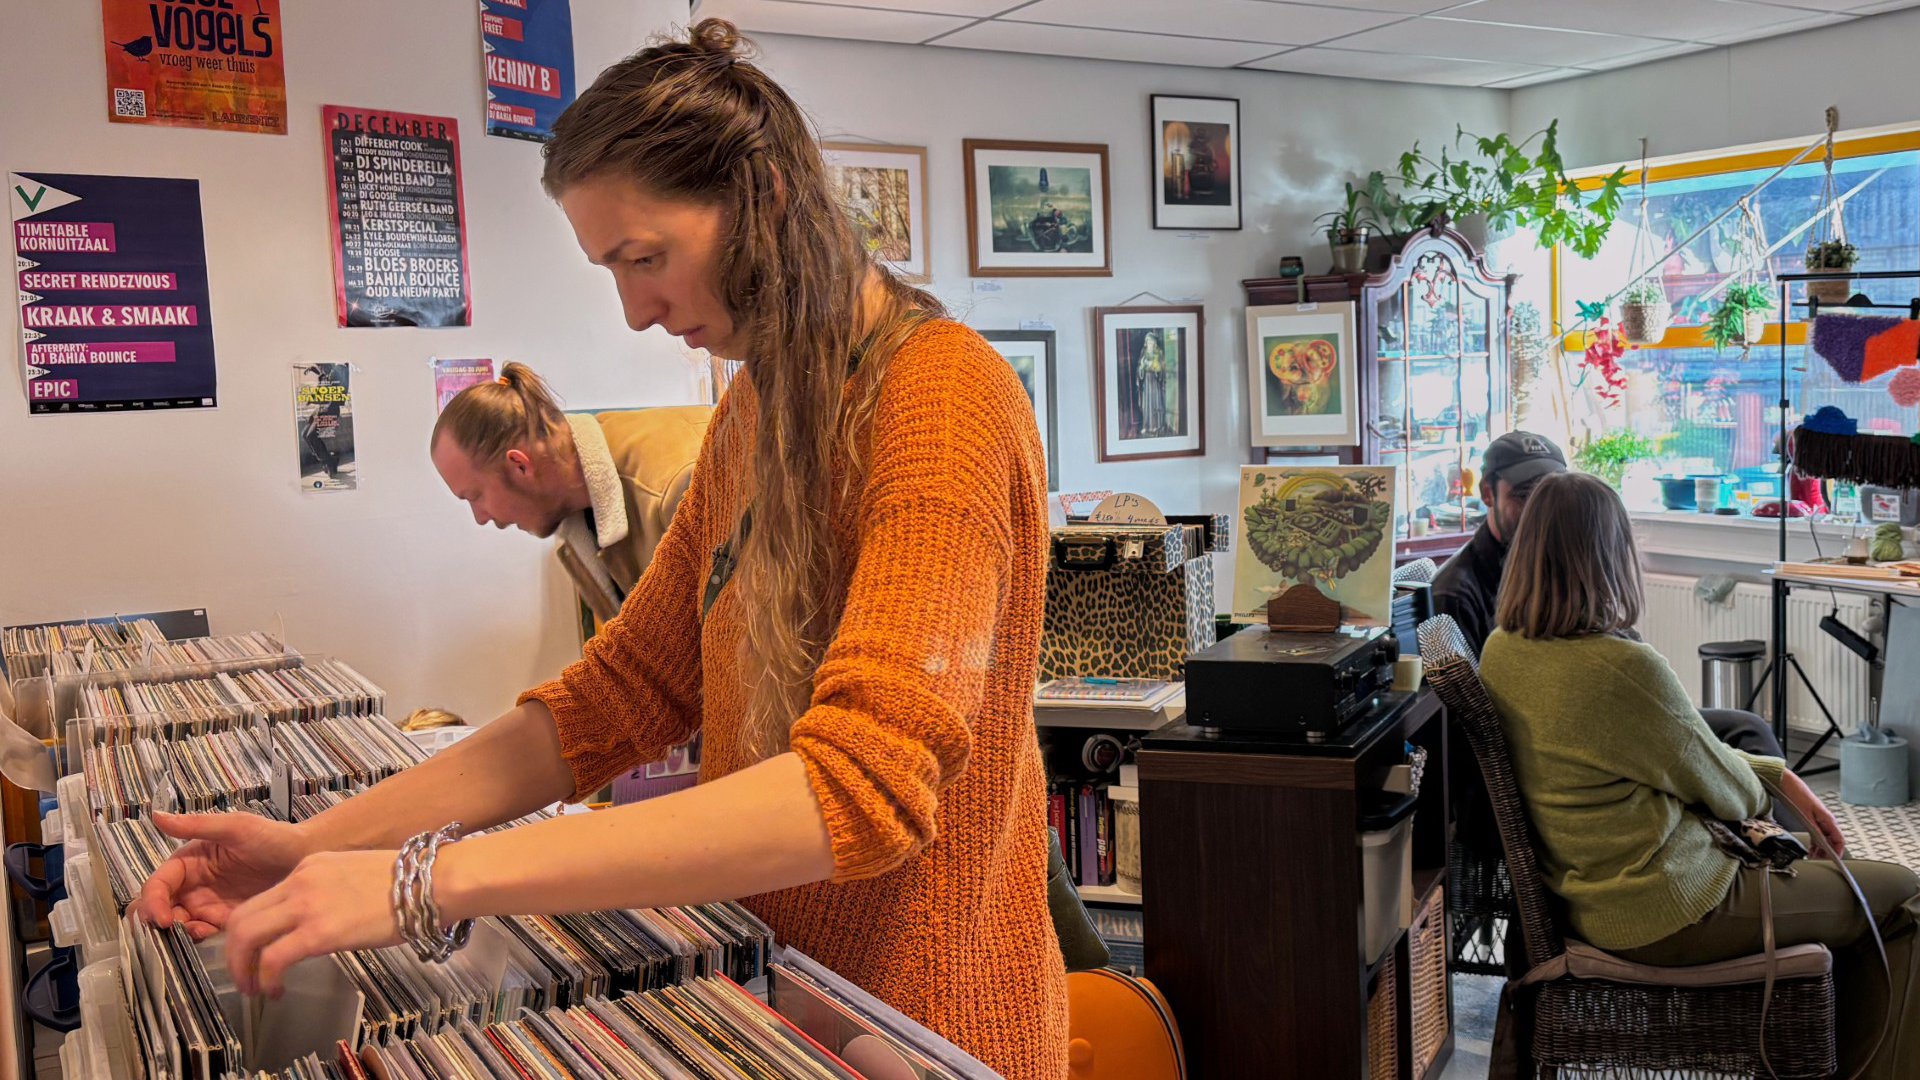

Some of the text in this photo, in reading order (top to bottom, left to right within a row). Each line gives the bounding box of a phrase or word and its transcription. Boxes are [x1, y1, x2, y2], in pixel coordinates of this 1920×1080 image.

[160, 54, 255, 74] vroeg weer thuis
[487, 55, 551, 91] KENNY B
[338, 112, 447, 139] DECEMBER
[513, 114, 533, 126] BOUNCE
[355, 137, 399, 149] DIFFERENT
[400, 141, 423, 151] COOK
[356, 156, 369, 169] DJ
[374, 157, 451, 174] SPINDERELLA
[358, 170, 435, 187] BOMMELBAND
[360, 183, 378, 191] LUCKY
[380, 184, 404, 192] MONDAY
[369, 191, 397, 201] GOOSIE
[360, 200, 387, 212] RUTH
[423, 203, 429, 213] &
[431, 203, 454, 215] BAND
[18, 223, 88, 237] TIMETABLE
[362, 218, 437, 233] KERSTSPECIAL
[20, 238, 110, 251] KORNUITZAAL
[386, 233, 428, 242] BOUDEWIJN
[434, 235, 456, 243] LOREN
[373, 249, 400, 257] GOOSIE
[364, 257, 407, 272] BLOES
[410, 258, 458, 273] BROERS
[24, 274, 170, 289] SECRET RENDEZVOUS
[366, 272, 407, 286] BAHIA
[410, 273, 460, 287] BOUNCE
[366, 287, 460, 298] OUD & NIEUW PARTY
[26, 306, 190, 326] KRAAK & SMAAK
[32, 343, 88, 353] AFTERPARTY:
[31, 351, 137, 364] DJ BAHIA BOUNCE
[34, 381, 70, 397] EPIC
[302, 386, 345, 395] STOEP
[298, 394, 352, 402] DANSEN
[1114, 496, 1140, 508] LP's
